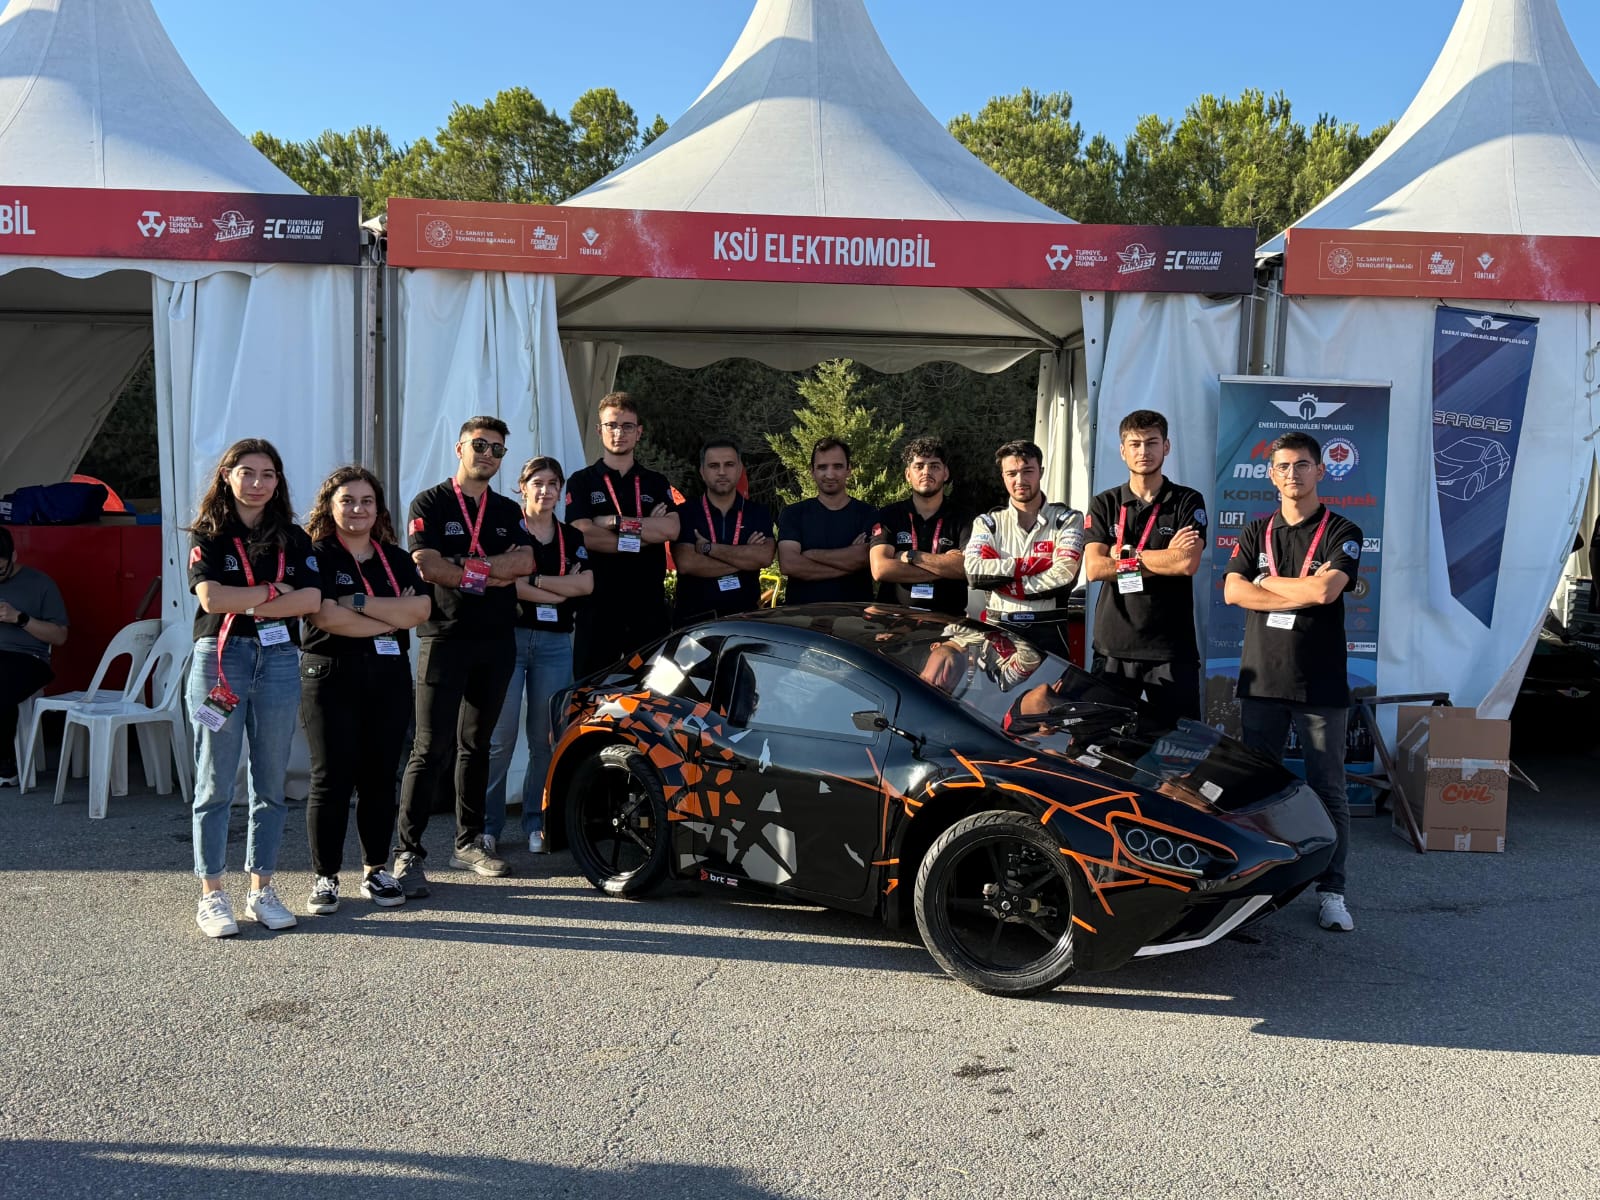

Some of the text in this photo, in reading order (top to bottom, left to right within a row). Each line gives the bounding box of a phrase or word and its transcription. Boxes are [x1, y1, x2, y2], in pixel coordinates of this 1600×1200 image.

[713, 227, 936, 268] KSÜ ELEKTROMOBİL
[1432, 410, 1512, 432] SARGAS
[1219, 511, 1245, 525] LOFT
[710, 873, 725, 883] brt
